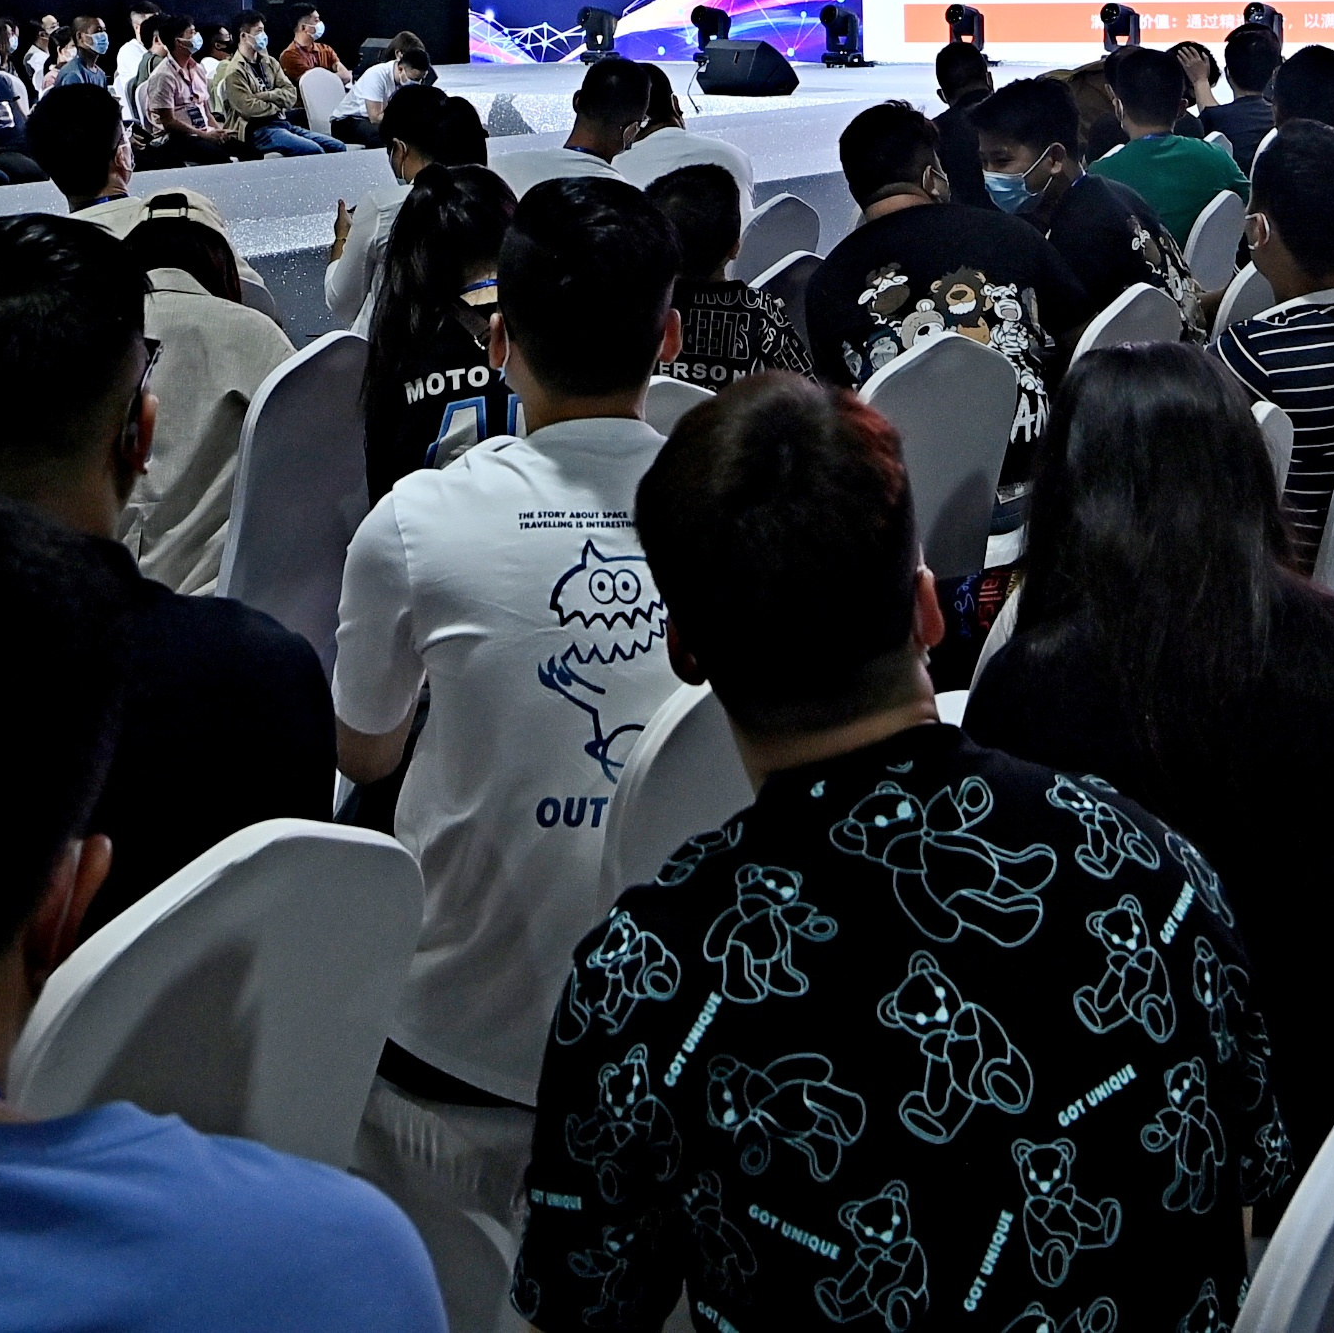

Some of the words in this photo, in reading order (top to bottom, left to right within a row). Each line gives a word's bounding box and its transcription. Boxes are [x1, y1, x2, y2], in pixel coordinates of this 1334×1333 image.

[404, 365, 490, 405] MOTO
[518, 511, 535, 520] THE
[537, 511, 566, 519] STORY
[569, 511, 599, 519] ABOUT
[602, 511, 628, 519] SPACE
[519, 521, 573, 530] TRAVELLING
[664, 1050, 688, 1088] GOT
[681, 990, 723, 1054] UNIQUE
[1057, 1098, 1087, 1128] GOT
[1084, 1063, 1138, 1108] UNIQUE
[748, 1203, 780, 1230] GOT
[780, 1219, 842, 1261] UNIQUE
[963, 1274, 988, 1313] GOT
[979, 1208, 1015, 1276] UNIQUE
